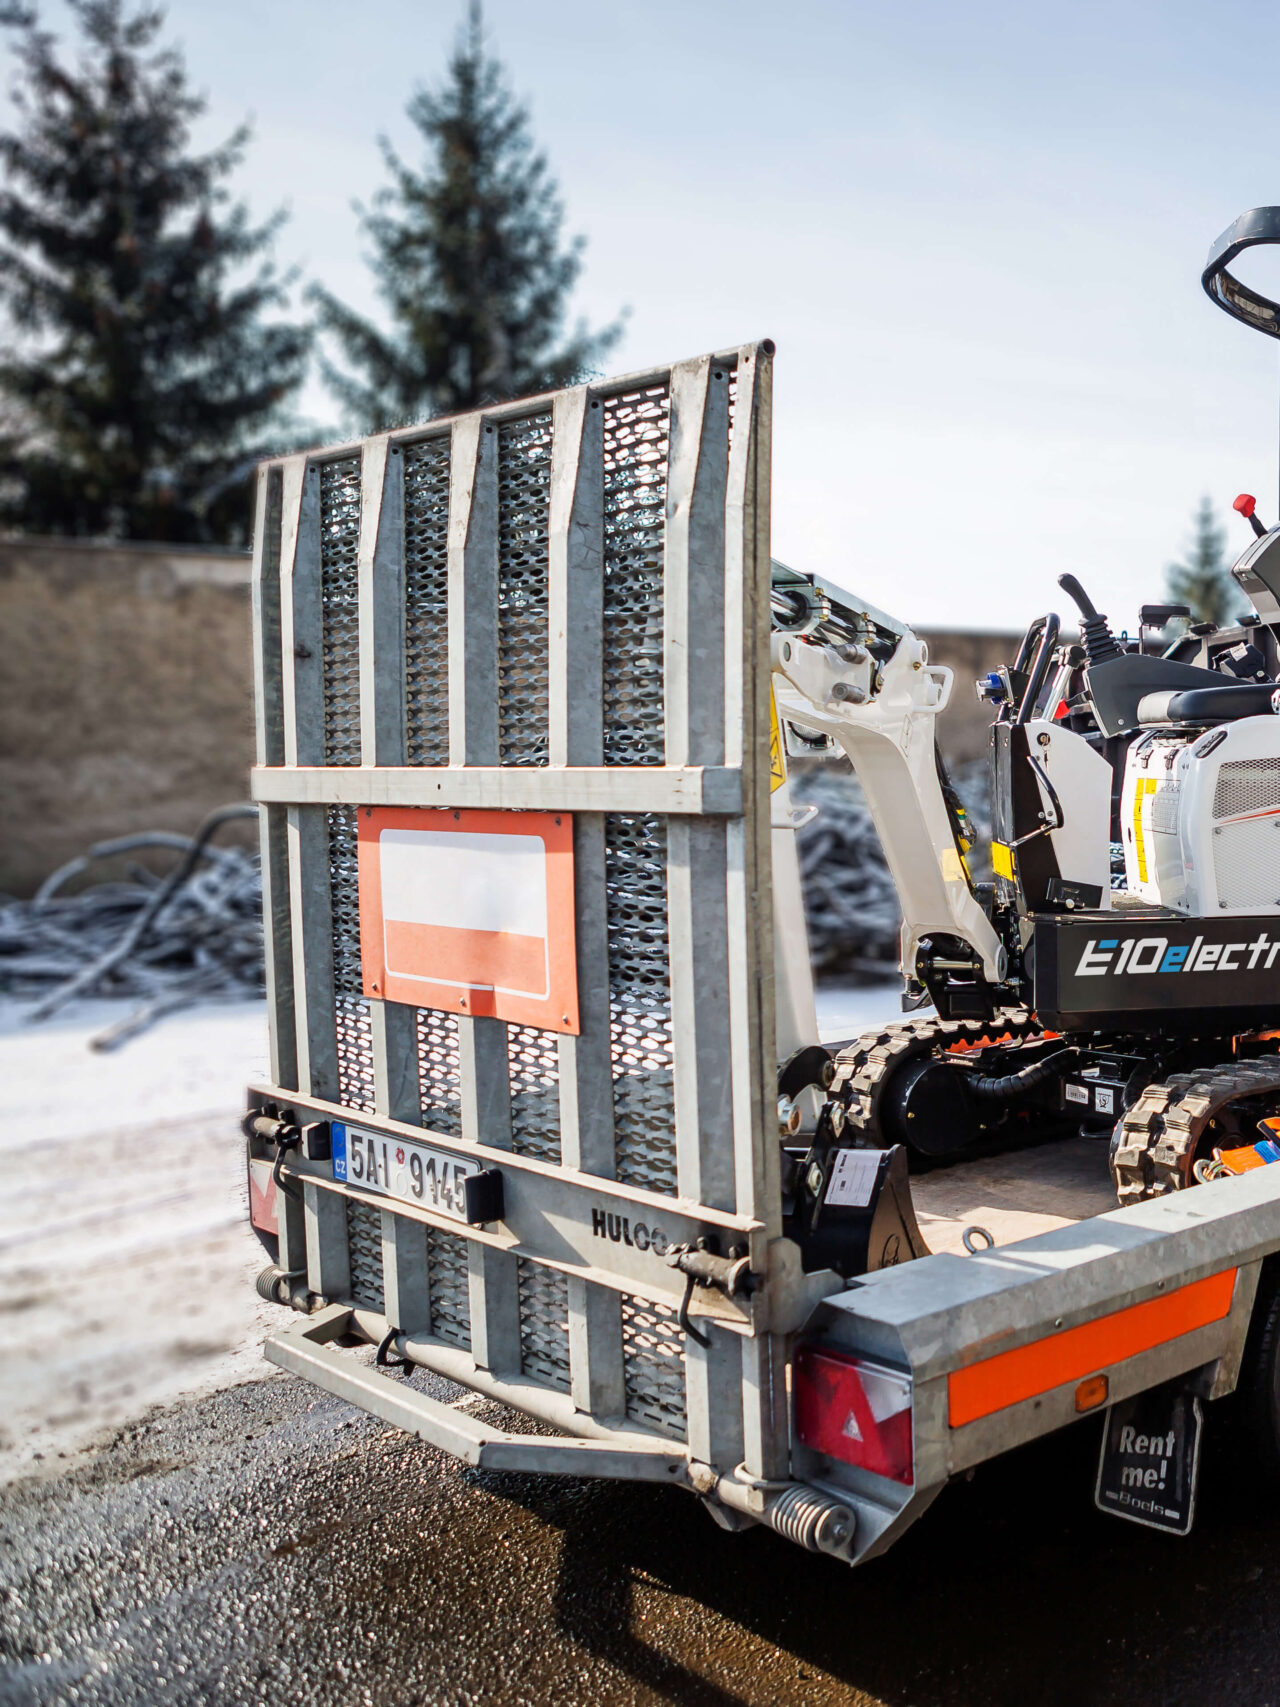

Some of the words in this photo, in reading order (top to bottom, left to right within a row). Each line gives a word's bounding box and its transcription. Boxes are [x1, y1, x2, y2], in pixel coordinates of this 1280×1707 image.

[335, 1159, 346, 1174] CZ
[409, 1152, 467, 1215] 9145
[1119, 1425, 1176, 1458] Rent
[1121, 1459, 1168, 1490] me!
